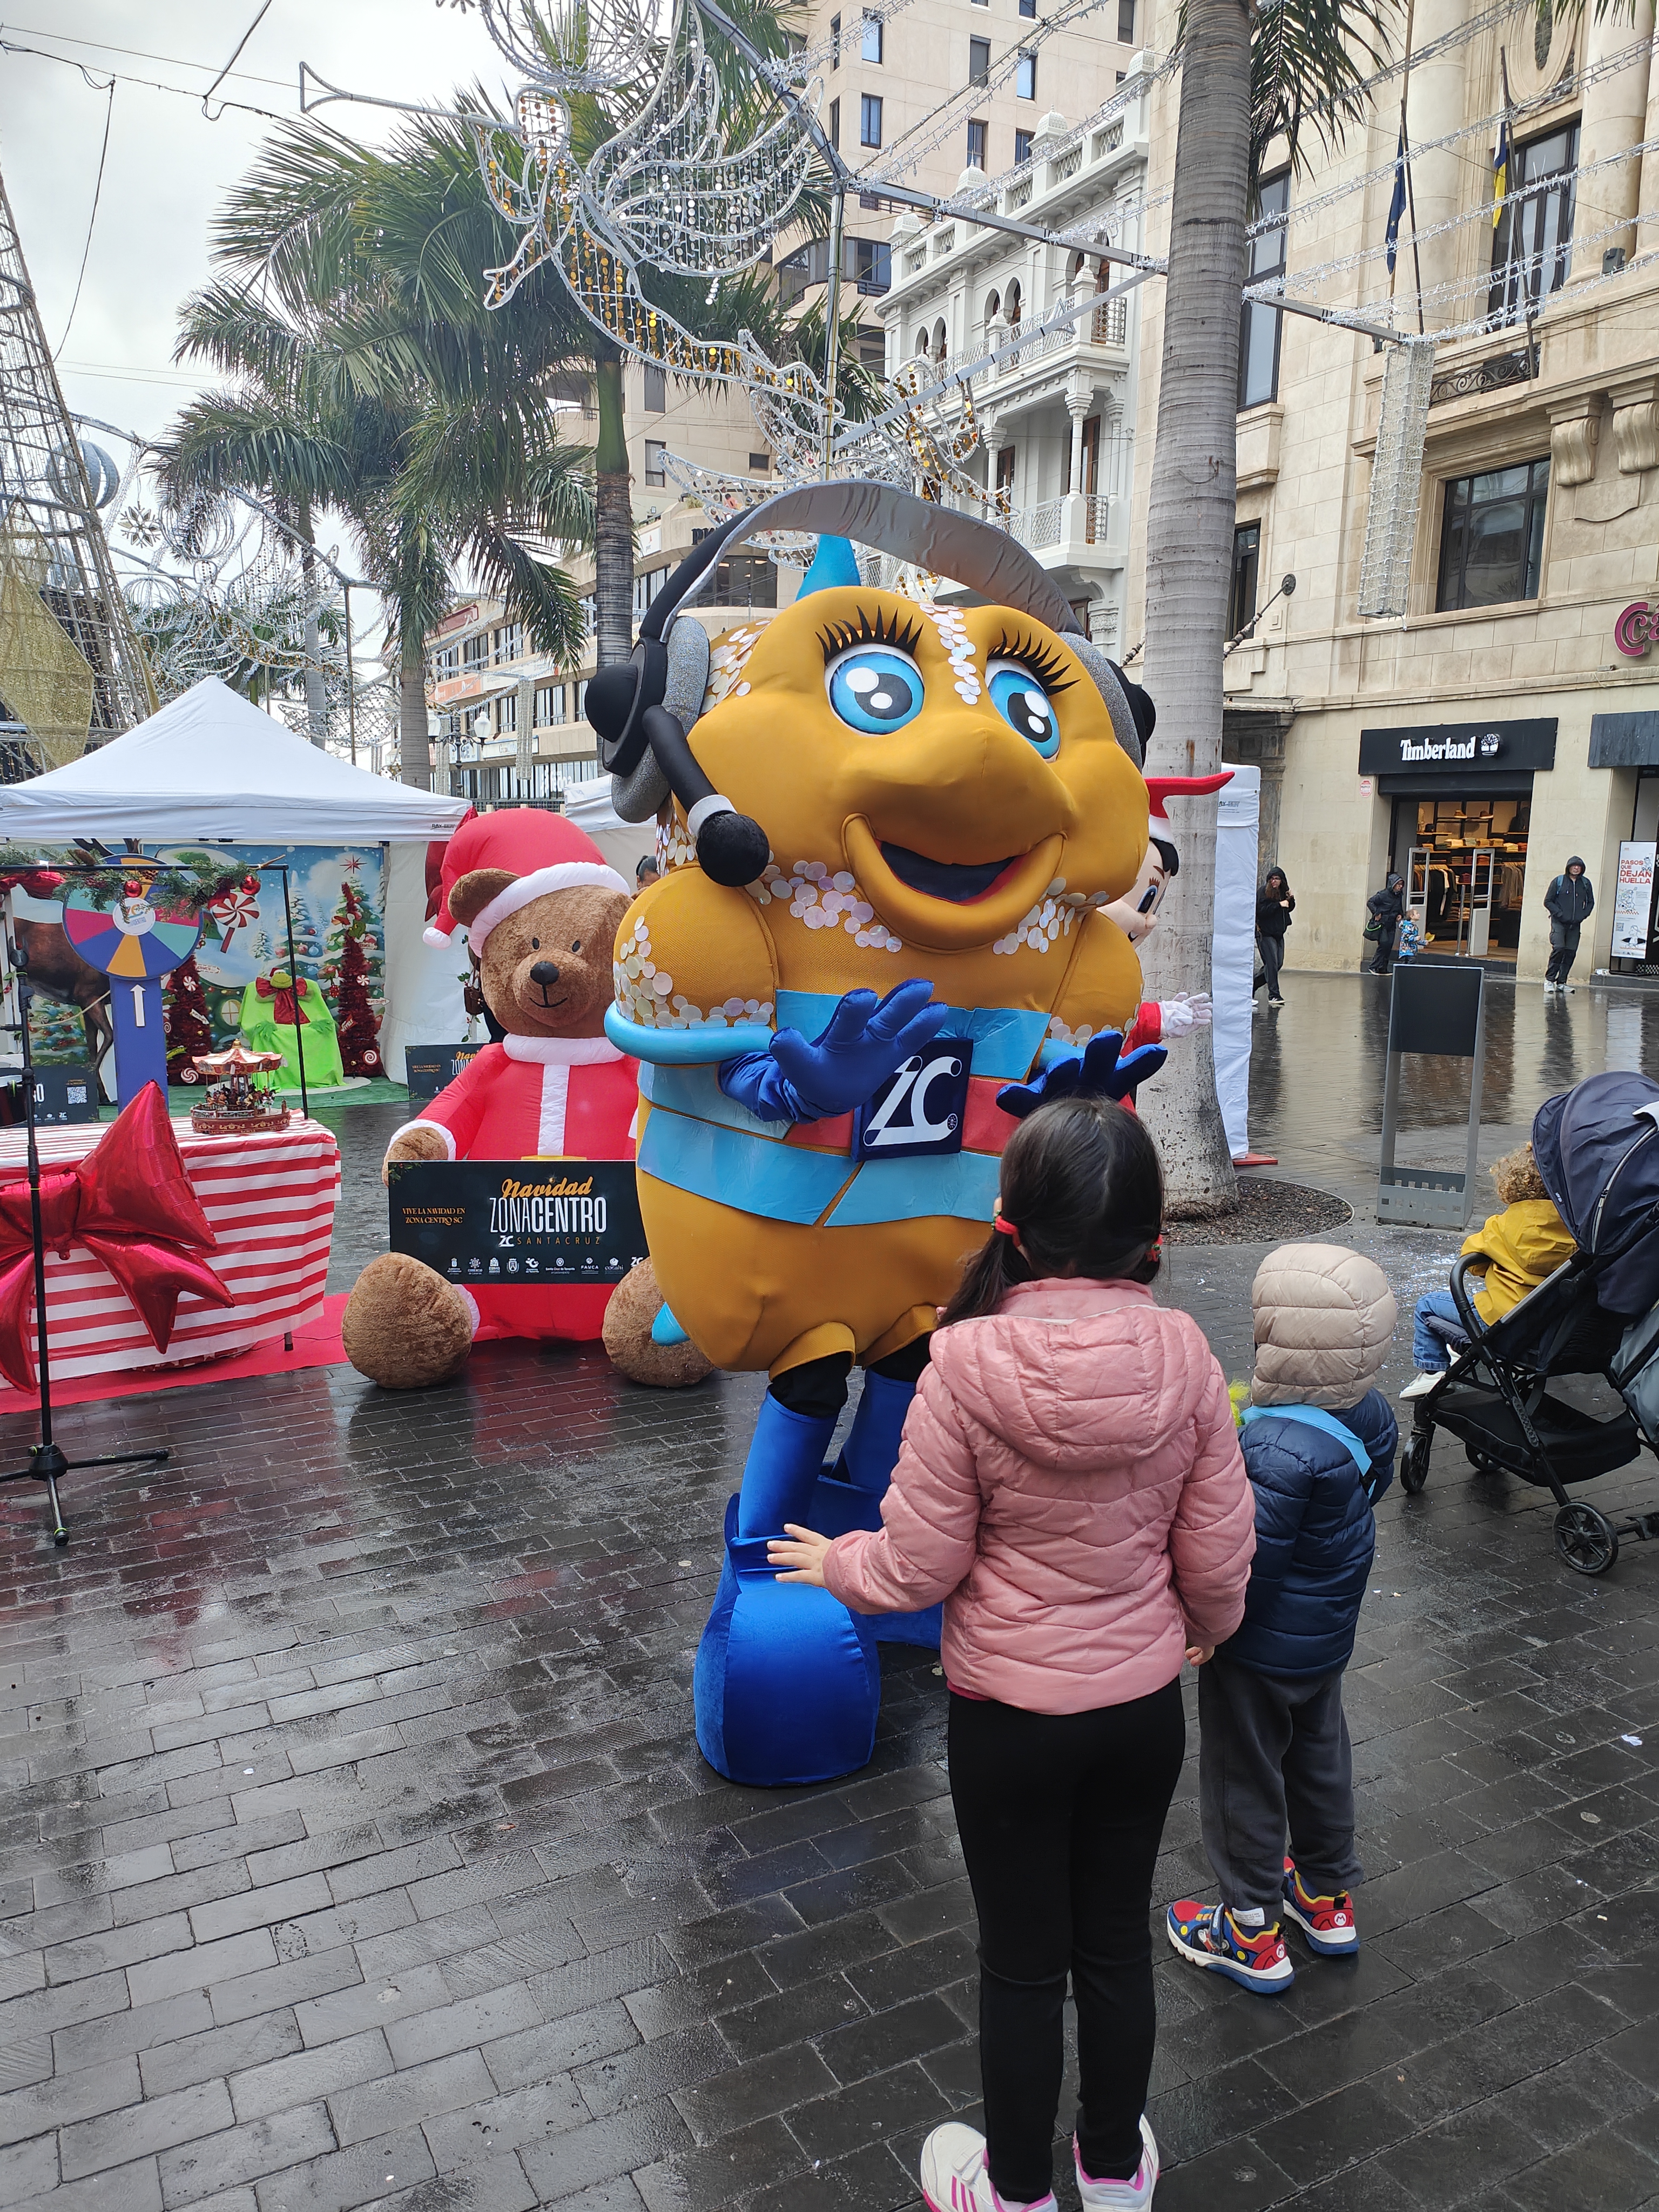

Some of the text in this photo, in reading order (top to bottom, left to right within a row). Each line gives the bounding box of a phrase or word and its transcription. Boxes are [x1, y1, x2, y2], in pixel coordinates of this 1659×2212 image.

[1400, 736, 1476, 761] Timberland
[864, 1056, 962, 1146] ZC
[502, 1176, 594, 1198] Navidad
[424, 1217, 452, 1225] CENTRO
[489, 1197, 606, 1233] ZONACENTRO
